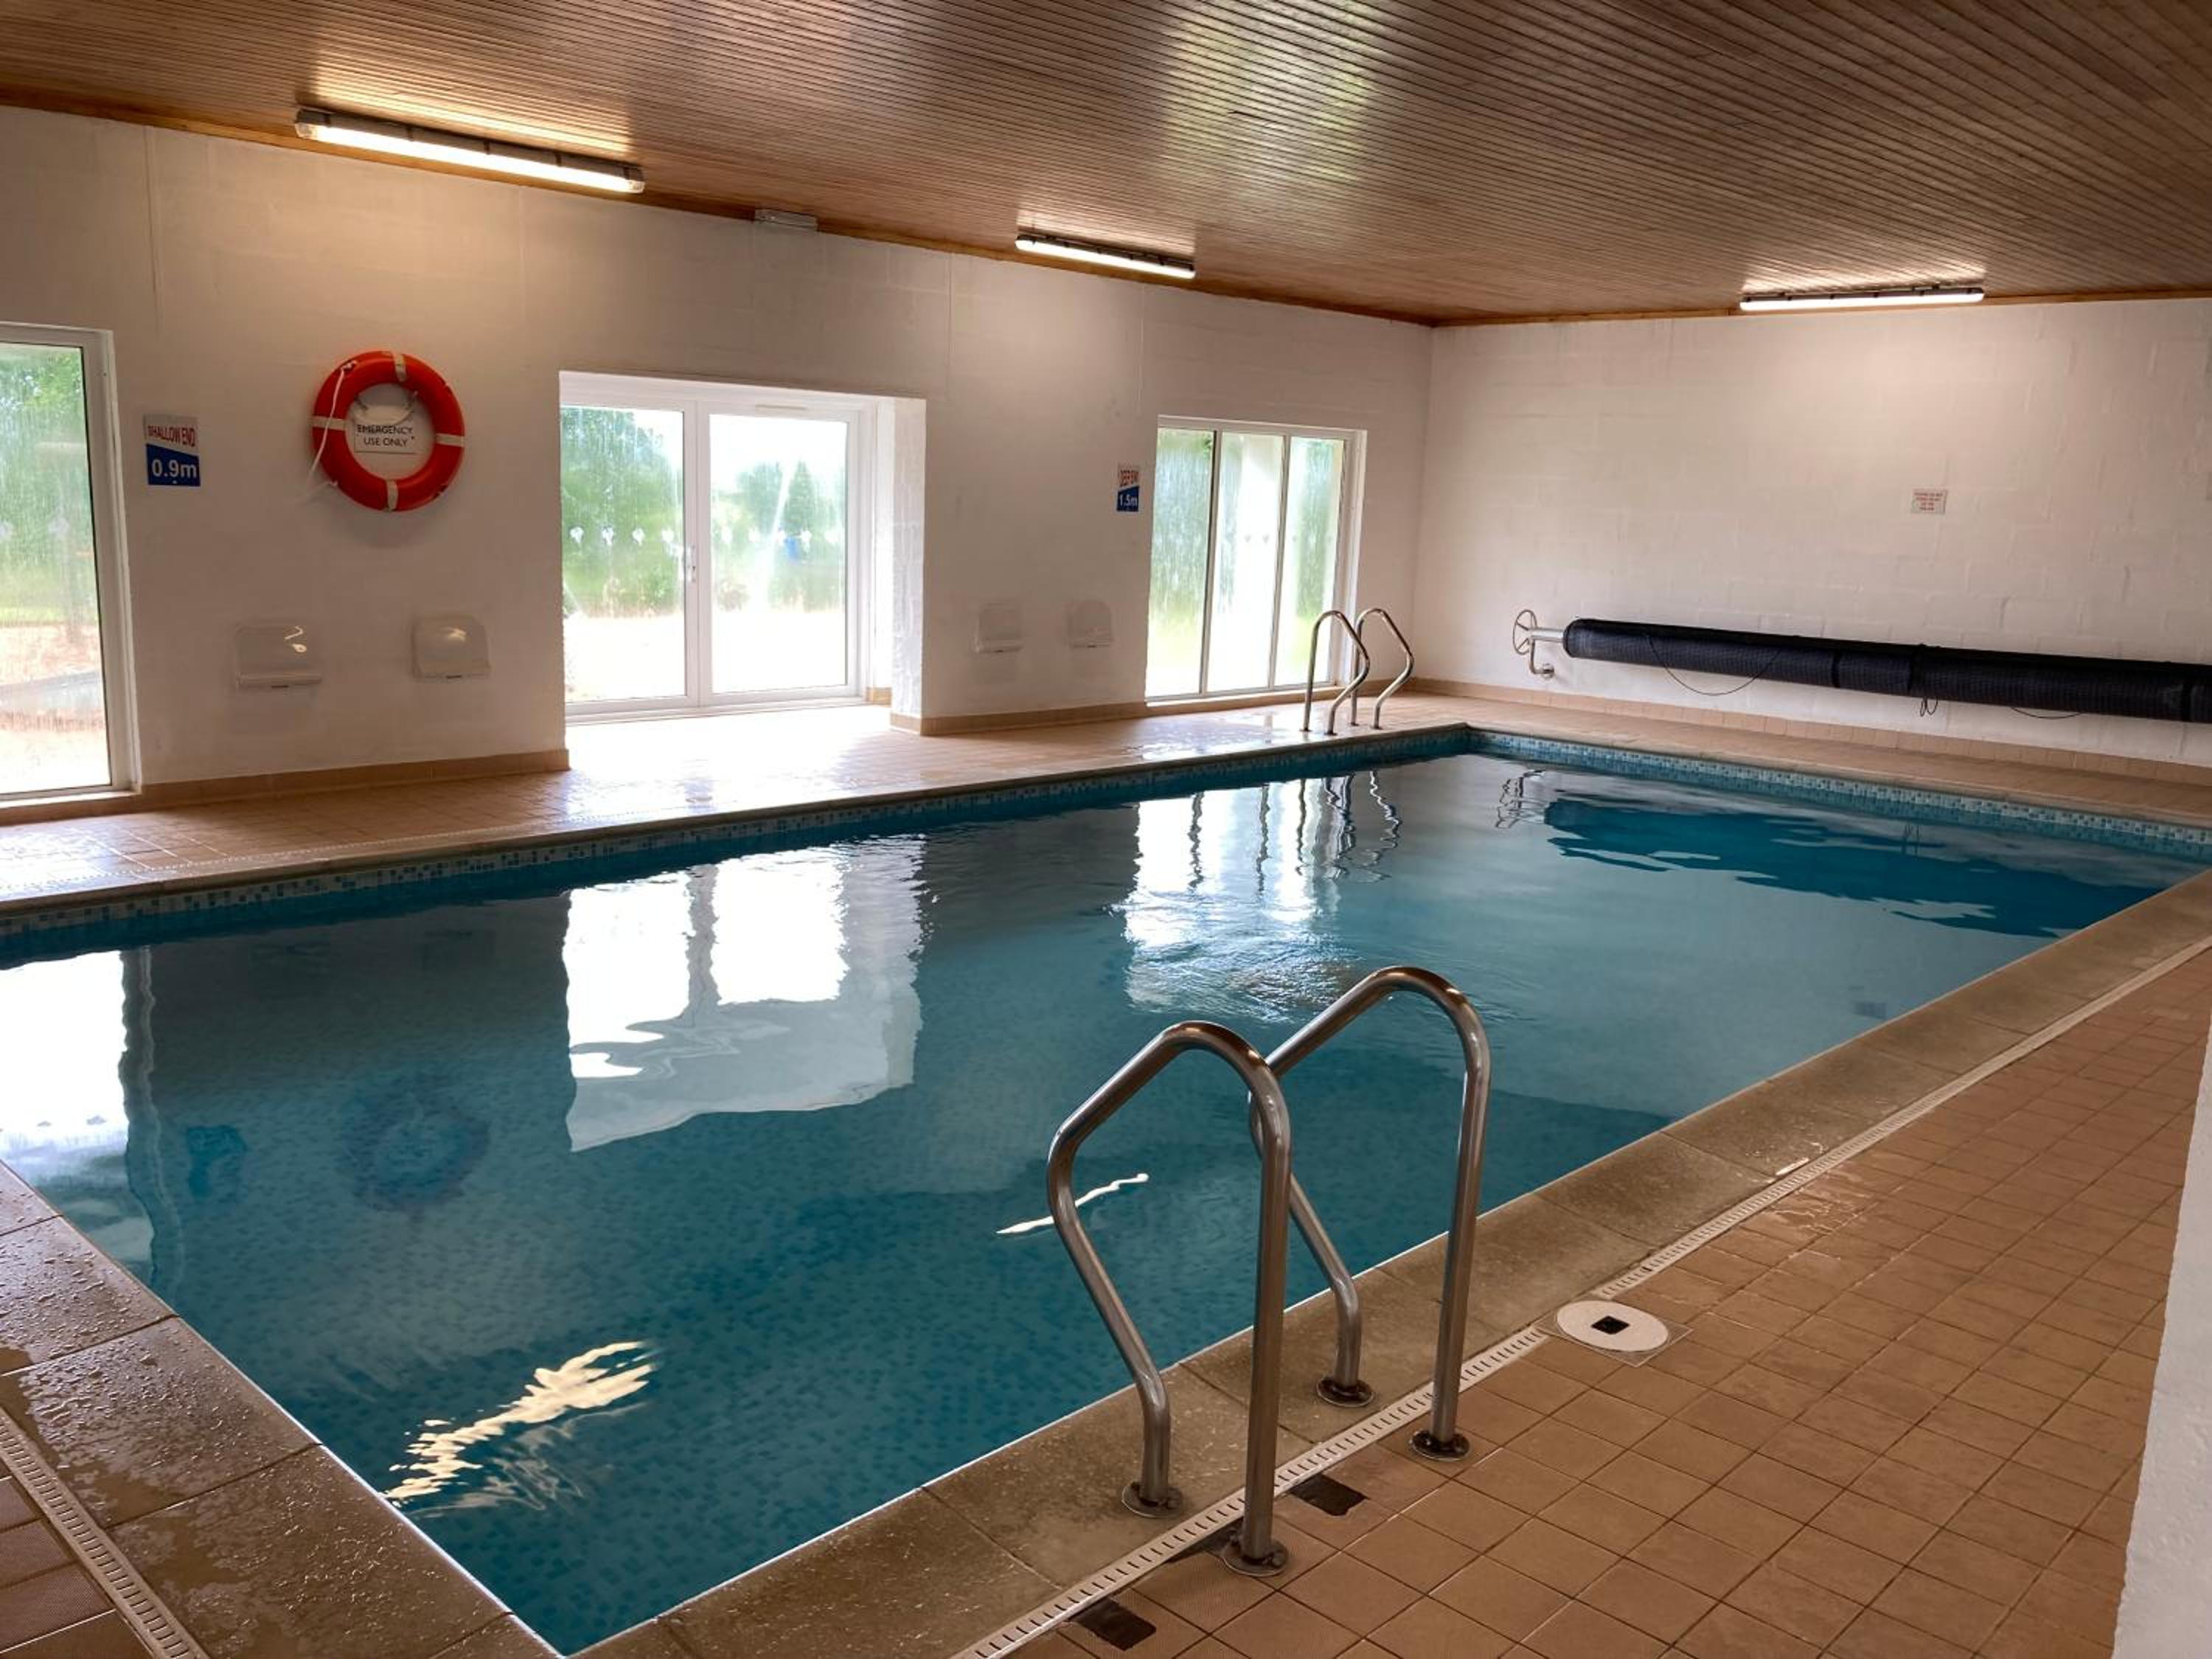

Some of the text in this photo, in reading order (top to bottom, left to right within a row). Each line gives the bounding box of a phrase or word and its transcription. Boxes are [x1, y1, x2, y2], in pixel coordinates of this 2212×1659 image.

[357, 424, 414, 434] EMERGENCY
[364, 437, 408, 448] USE ONLY
[152, 459, 197, 478] 0.9m
